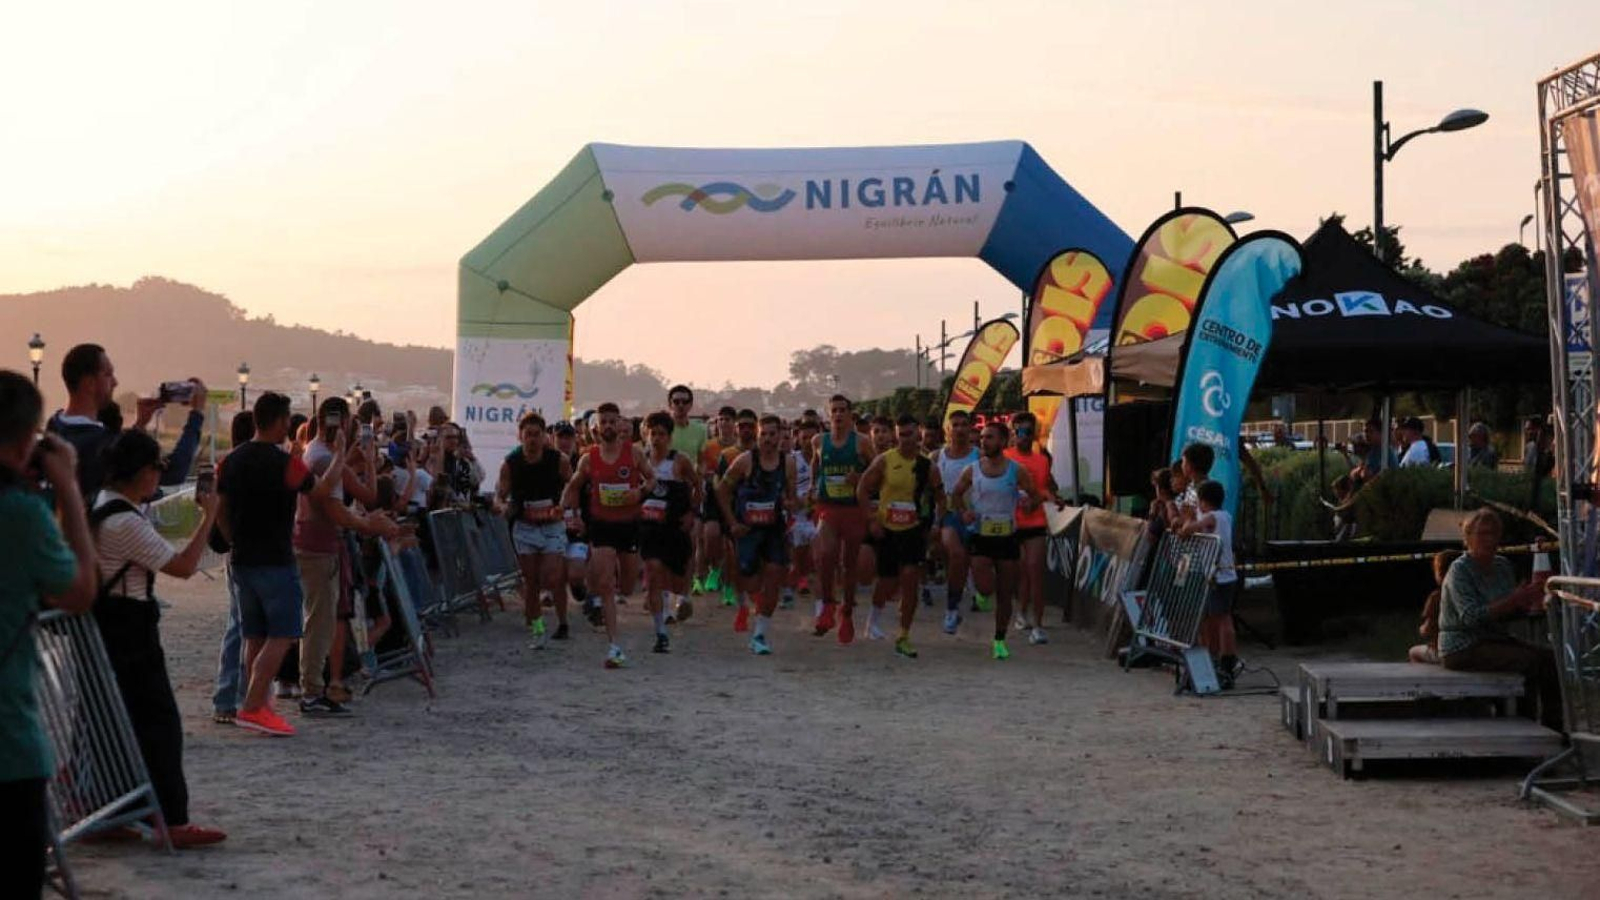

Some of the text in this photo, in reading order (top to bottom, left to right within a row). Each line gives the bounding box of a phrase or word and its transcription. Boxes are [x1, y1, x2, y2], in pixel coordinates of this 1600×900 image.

[805, 168, 981, 210] NIGRÁN
[1201, 319, 1262, 355] CENTRO DE
